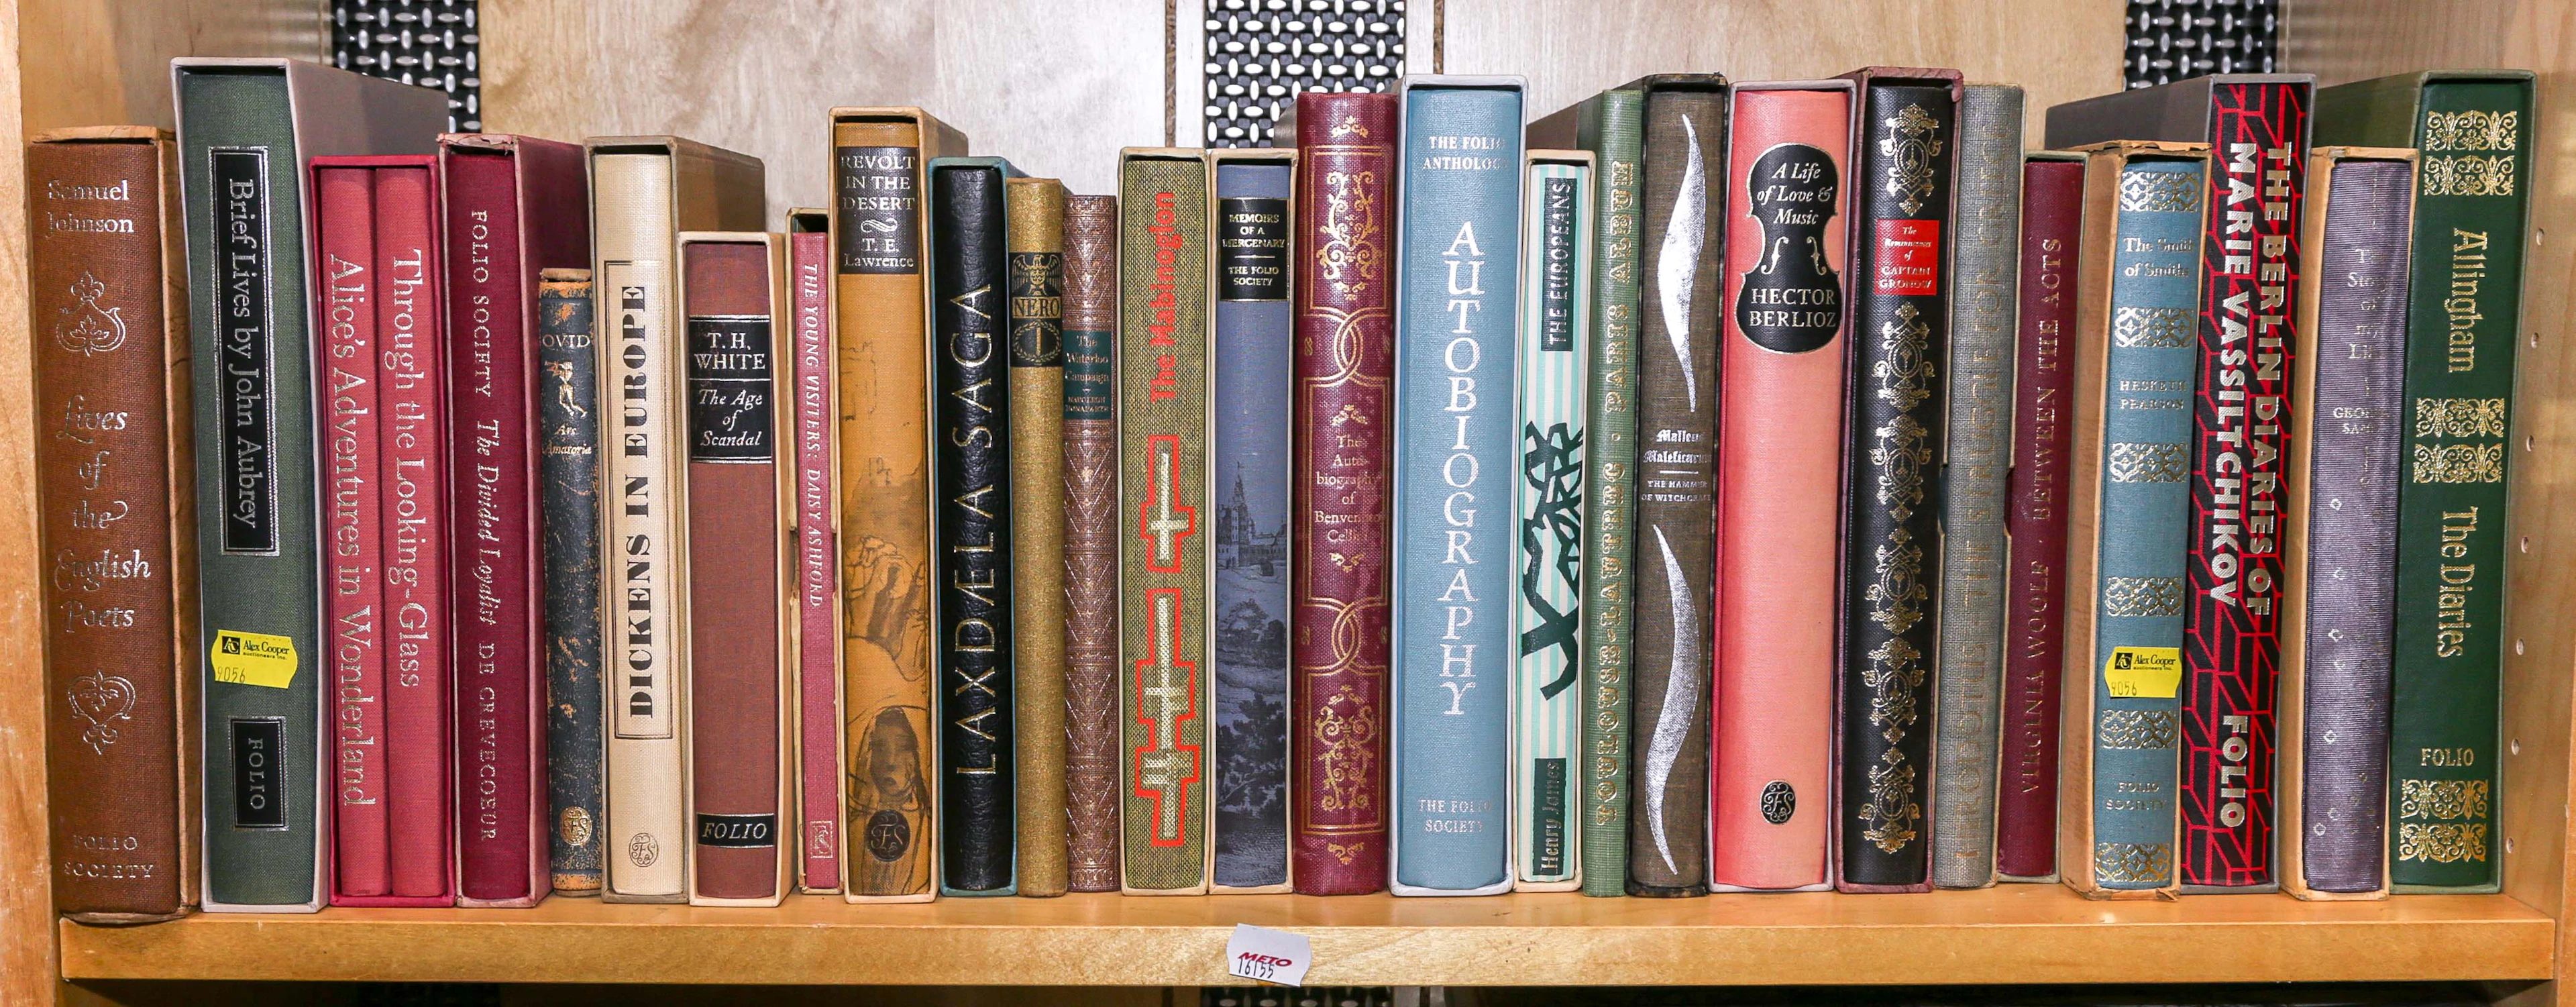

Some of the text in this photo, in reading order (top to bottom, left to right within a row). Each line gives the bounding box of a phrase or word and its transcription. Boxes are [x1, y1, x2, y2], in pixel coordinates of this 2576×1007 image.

[1429, 137, 1505, 150] THE FOLIO
[841, 156, 915, 170] REVOLT
[1423, 156, 1510, 170] ANTHOLOG
[1772, 162, 1821, 180] A Life
[48, 179, 129, 201] Samuel
[846, 176, 910, 189] IN THE
[843, 197, 914, 211] DESERT
[1757, 186, 1833, 205] of Love &
[1229, 214, 1279, 223] MEMOIRS
[1773, 208, 1819, 225] Music
[45, 213, 134, 238] Johnson
[1240, 226, 1265, 235] OF A
[1903, 226, 1917, 235] The
[862, 237, 900, 252] T. E.
[2124, 237, 2153, 252] The
[844, 254, 914, 268] Lawrence
[1549, 182, 1570, 346] THE EUROPEANS
[1904, 250, 1913, 262] of
[1228, 266, 1279, 274] THE FOLIO
[2125, 263, 2141, 276] of
[1234, 277, 1273, 285] SOCIETY
[1149, 193, 1179, 401] The Mabinogion
[1752, 288, 1835, 307] HECTOR
[1974, 268, 2000, 331] FOR
[2444, 227, 2487, 373] Allingham
[1012, 297, 1059, 317] NERO
[1749, 310, 1836, 329] BERLIOZ
[542, 334, 590, 348] OVID
[1077, 335, 1097, 346] The
[228, 178, 264, 528] Brief Lives by John Aubrey
[694, 353, 765, 370] WHITE
[1067, 352, 1108, 363] Waterloo
[951, 284, 992, 448] SAGA
[2210, 142, 2257, 606] MARIE VASSILTCHIKOV
[1065, 371, 1109, 384] Campaign
[2120, 380, 2186, 391] HESKETH
[2247, 142, 2292, 615] THE BERLIN DIARIES OF
[699, 388, 763, 411] The Age
[2120, 399, 2184, 410] PEARSON
[56, 395, 127, 443] Lives
[722, 411, 739, 428] of
[700, 431, 762, 447] Scandal
[804, 264, 821, 606] THE YOUNG VISITERS: DAISY ASHFORD
[1337, 435, 1365, 447] The
[1656, 429, 1703, 442] Malleu
[1969, 351, 1997, 520] STRUGGLE
[80, 449, 110, 490] of
[384, 249, 428, 687] Through the Looking-Glass
[1437, 221, 1485, 715] AUTOBIOGRAPHY
[1342, 491, 1356, 505] of
[1596, 161, 1632, 825] TOULOUSE-LAUTREC PARIS ALBUM
[623, 286, 653, 718] DICKENS IN EUROPE
[72, 500, 128, 530] the
[1315, 511, 1382, 523] Benven
[2022, 239, 2061, 792] VIRGINIA WOOLF BETWEEN THE ACTS
[330, 255, 376, 806] Alice's Adventures in Wonderland
[471, 211, 501, 840] FOLIO SOCIETY The Divided Loyalist DE CREVECOEUR
[1327, 529, 1367, 541] Celli
[55, 549, 151, 592] English
[1964, 541, 1990, 605] THE
[2436, 507, 2478, 657] The Diaries
[62, 600, 135, 633] Poets
[243, 640, 289, 655] Alex Cooper
[2134, 655, 2176, 666] Alex Cooper
[217, 666, 246, 683] 9056
[2112, 681, 2137, 696] 9056
[1955, 643, 1984, 861] HERODOTUS
[2421, 747, 2473, 766] FOLIO
[248, 738, 265, 810] FOLIO
[2221, 715, 2249, 827] FOLIO
[2118, 782, 2159, 792] FOLIO
[1419, 800, 1491, 812] THE FOLIO
[1542, 761, 1562, 871] Henry James
[702, 823, 767, 840] FOLIO
[1425, 819, 1484, 833] SOCIETY
[73, 836, 138, 850] FOLIO
[64, 863, 154, 879] SOCIETY
[1238, 952, 1293, 967] METO
[1238, 957, 1274, 978] 16155
